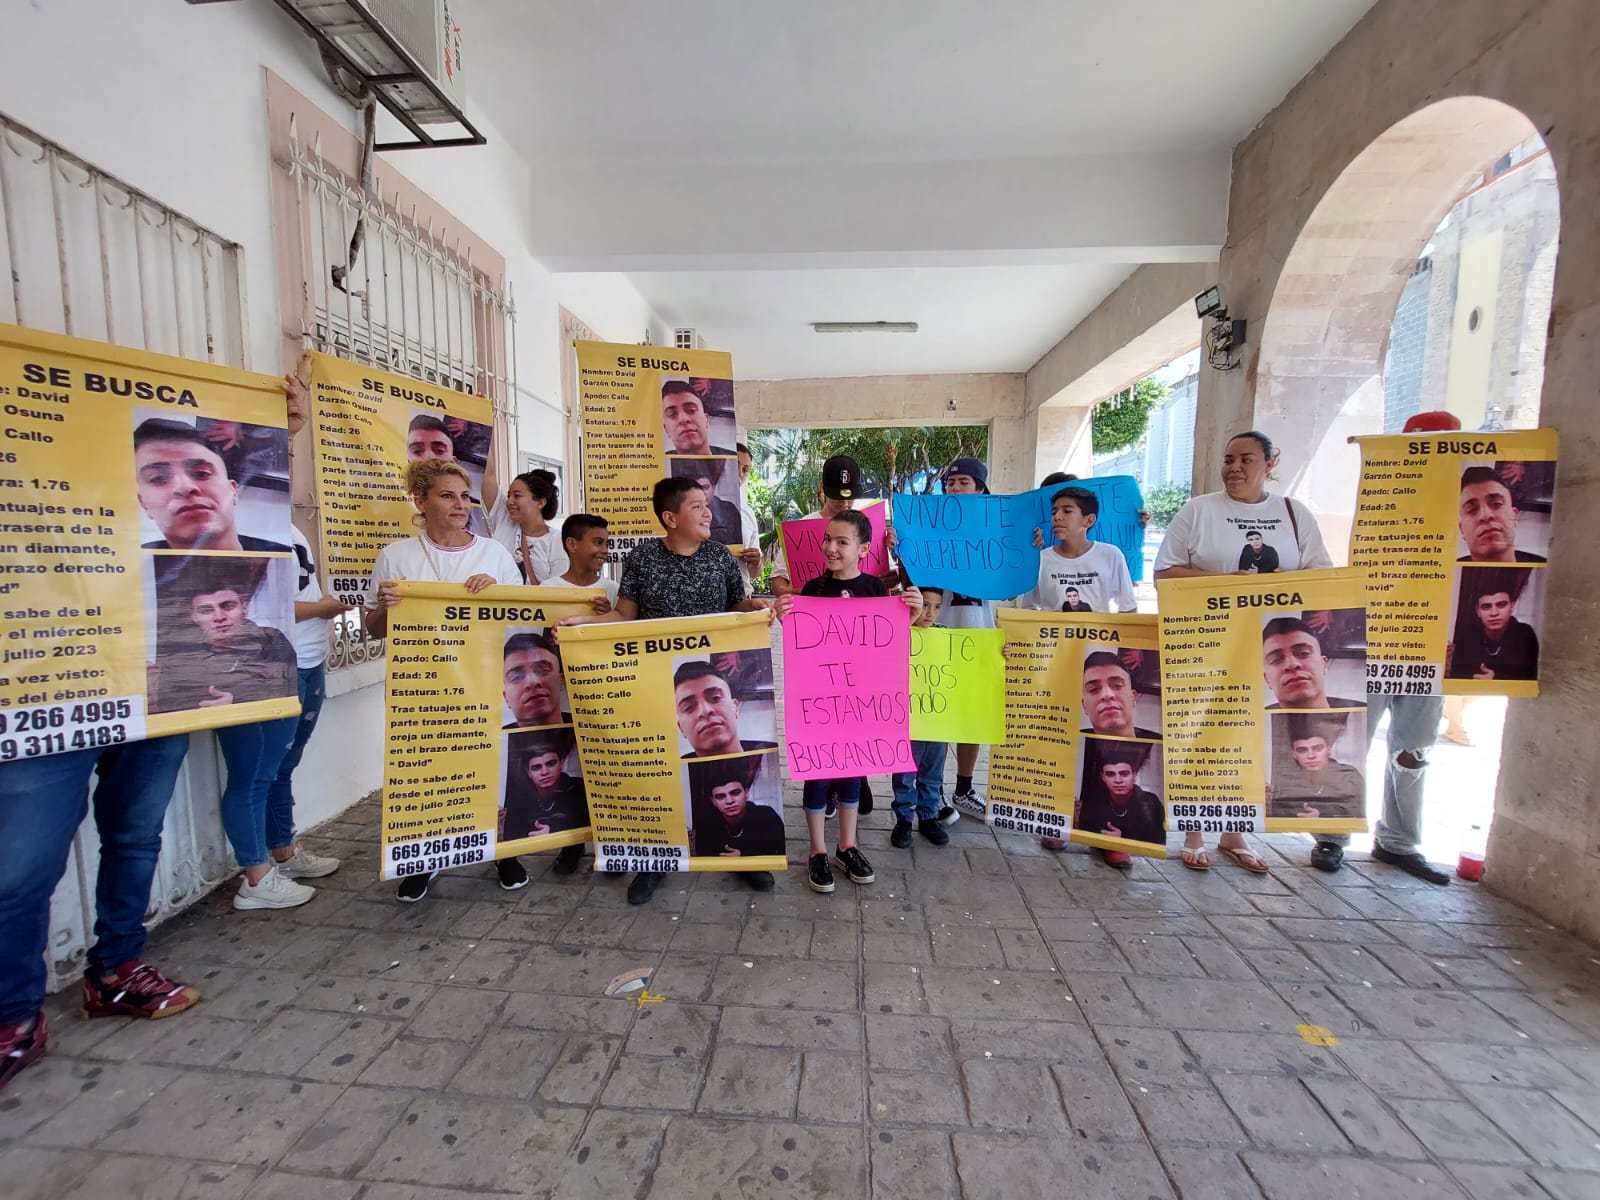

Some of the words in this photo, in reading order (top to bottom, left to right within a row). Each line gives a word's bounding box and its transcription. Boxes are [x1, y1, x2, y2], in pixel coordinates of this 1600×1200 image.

[618, 357, 636, 368] SE
[641, 358, 690, 372] BUSCA
[23, 364, 71, 388] SE
[85, 372, 199, 407] BUSCA
[17, 387, 69, 403] David
[356, 392, 382, 403] David
[362, 379, 384, 393] SE
[390, 386, 446, 409] BUSCA
[4, 405, 64, 422] Osuna
[319, 410, 351, 419] Apodo:
[5, 428, 53, 443] Callo
[320, 424, 346, 434] Edad:
[321, 439, 363, 450] Estatura:
[1409, 442, 1430, 454] SE
[1437, 442, 1497, 454] BUSCA
[31, 479, 70, 491] 1.76
[1361, 488, 1390, 496] Apodo:
[894, 495, 962, 531] VIVO
[976, 496, 1016, 528] TE
[71, 524, 92, 534] de
[98, 526, 113, 535] la
[25, 543, 115, 556] diamante,
[898, 536, 1024, 570] QUEREMOS
[54, 563, 125, 573] derecho
[334, 578, 358, 591] 669
[1207, 597, 1230, 610] SE
[1237, 593, 1303, 608] BUSCA
[4, 608, 50, 619] sabe
[57, 607, 79, 617] de
[86, 606, 101, 616] el
[445, 606, 470, 620] SE
[478, 608, 546, 621] BUSCA
[1204, 613, 1229, 621] David
[8, 628, 26, 639] el
[34, 625, 122, 638] miércoles
[788, 611, 893, 649] DAVID
[1040, 628, 1059, 638] SE
[1065, 628, 1120, 642] BUSCA
[614, 642, 638, 656] SE
[645, 635, 710, 653] BUSCA
[947, 633, 974, 661] Te
[1165, 643, 1195, 651] Apodo:
[3, 649, 46, 663] julio
[53, 645, 96, 657] 2023
[392, 655, 428, 664] Apodo:
[568, 664, 608, 672] Nombre:
[612, 659, 638, 668] David
[1381, 664, 1404, 678] 266
[1406, 665, 1436, 678] 4995
[16, 675, 50, 684] vez
[56, 669, 104, 680] visto:
[819, 662, 856, 687] TE
[1384, 681, 1402, 694] 311
[1404, 682, 1432, 694] 4183
[18, 692, 47, 704] del
[54, 688, 108, 700] ébano
[573, 693, 604, 701] Apodo:
[607, 690, 631, 698] Callo
[418, 705, 461, 713] tatuajes
[801, 692, 905, 724] ESTAMOS
[14, 707, 64, 732] 266
[70, 700, 130, 724] 4995
[24, 733, 64, 756] 311
[72, 724, 126, 748] 4183
[789, 739, 909, 773] BUSCANDO
[389, 790, 420, 799] desde
[437, 784, 486, 795] miércoles
[993, 804, 1012, 817] 669
[1015, 808, 1035, 821] 266
[1037, 812, 1065, 826] 4995
[1174, 805, 1196, 816] 669
[1200, 805, 1222, 817] 266
[1225, 805, 1256, 817] 4995
[994, 818, 1014, 830] 669
[1017, 822, 1033, 833] 311
[1034, 826, 1060, 838] 4183
[1178, 820, 1201, 831] 669
[1204, 820, 1222, 832] 311
[1226, 821, 1254, 833] 4183
[392, 844, 420, 861] 669
[424, 838, 450, 856] 266
[453, 833, 487, 850] 4995
[602, 845, 625, 856] 669
[627, 846, 649, 856] 266
[652, 847, 681, 857] 4995
[396, 860, 424, 876] 669
[428, 855, 449, 870] 311
[452, 849, 483, 865] 4183
[606, 859, 628, 870] 669
[632, 859, 649, 871] 311
[652, 860, 678, 871] 4183
